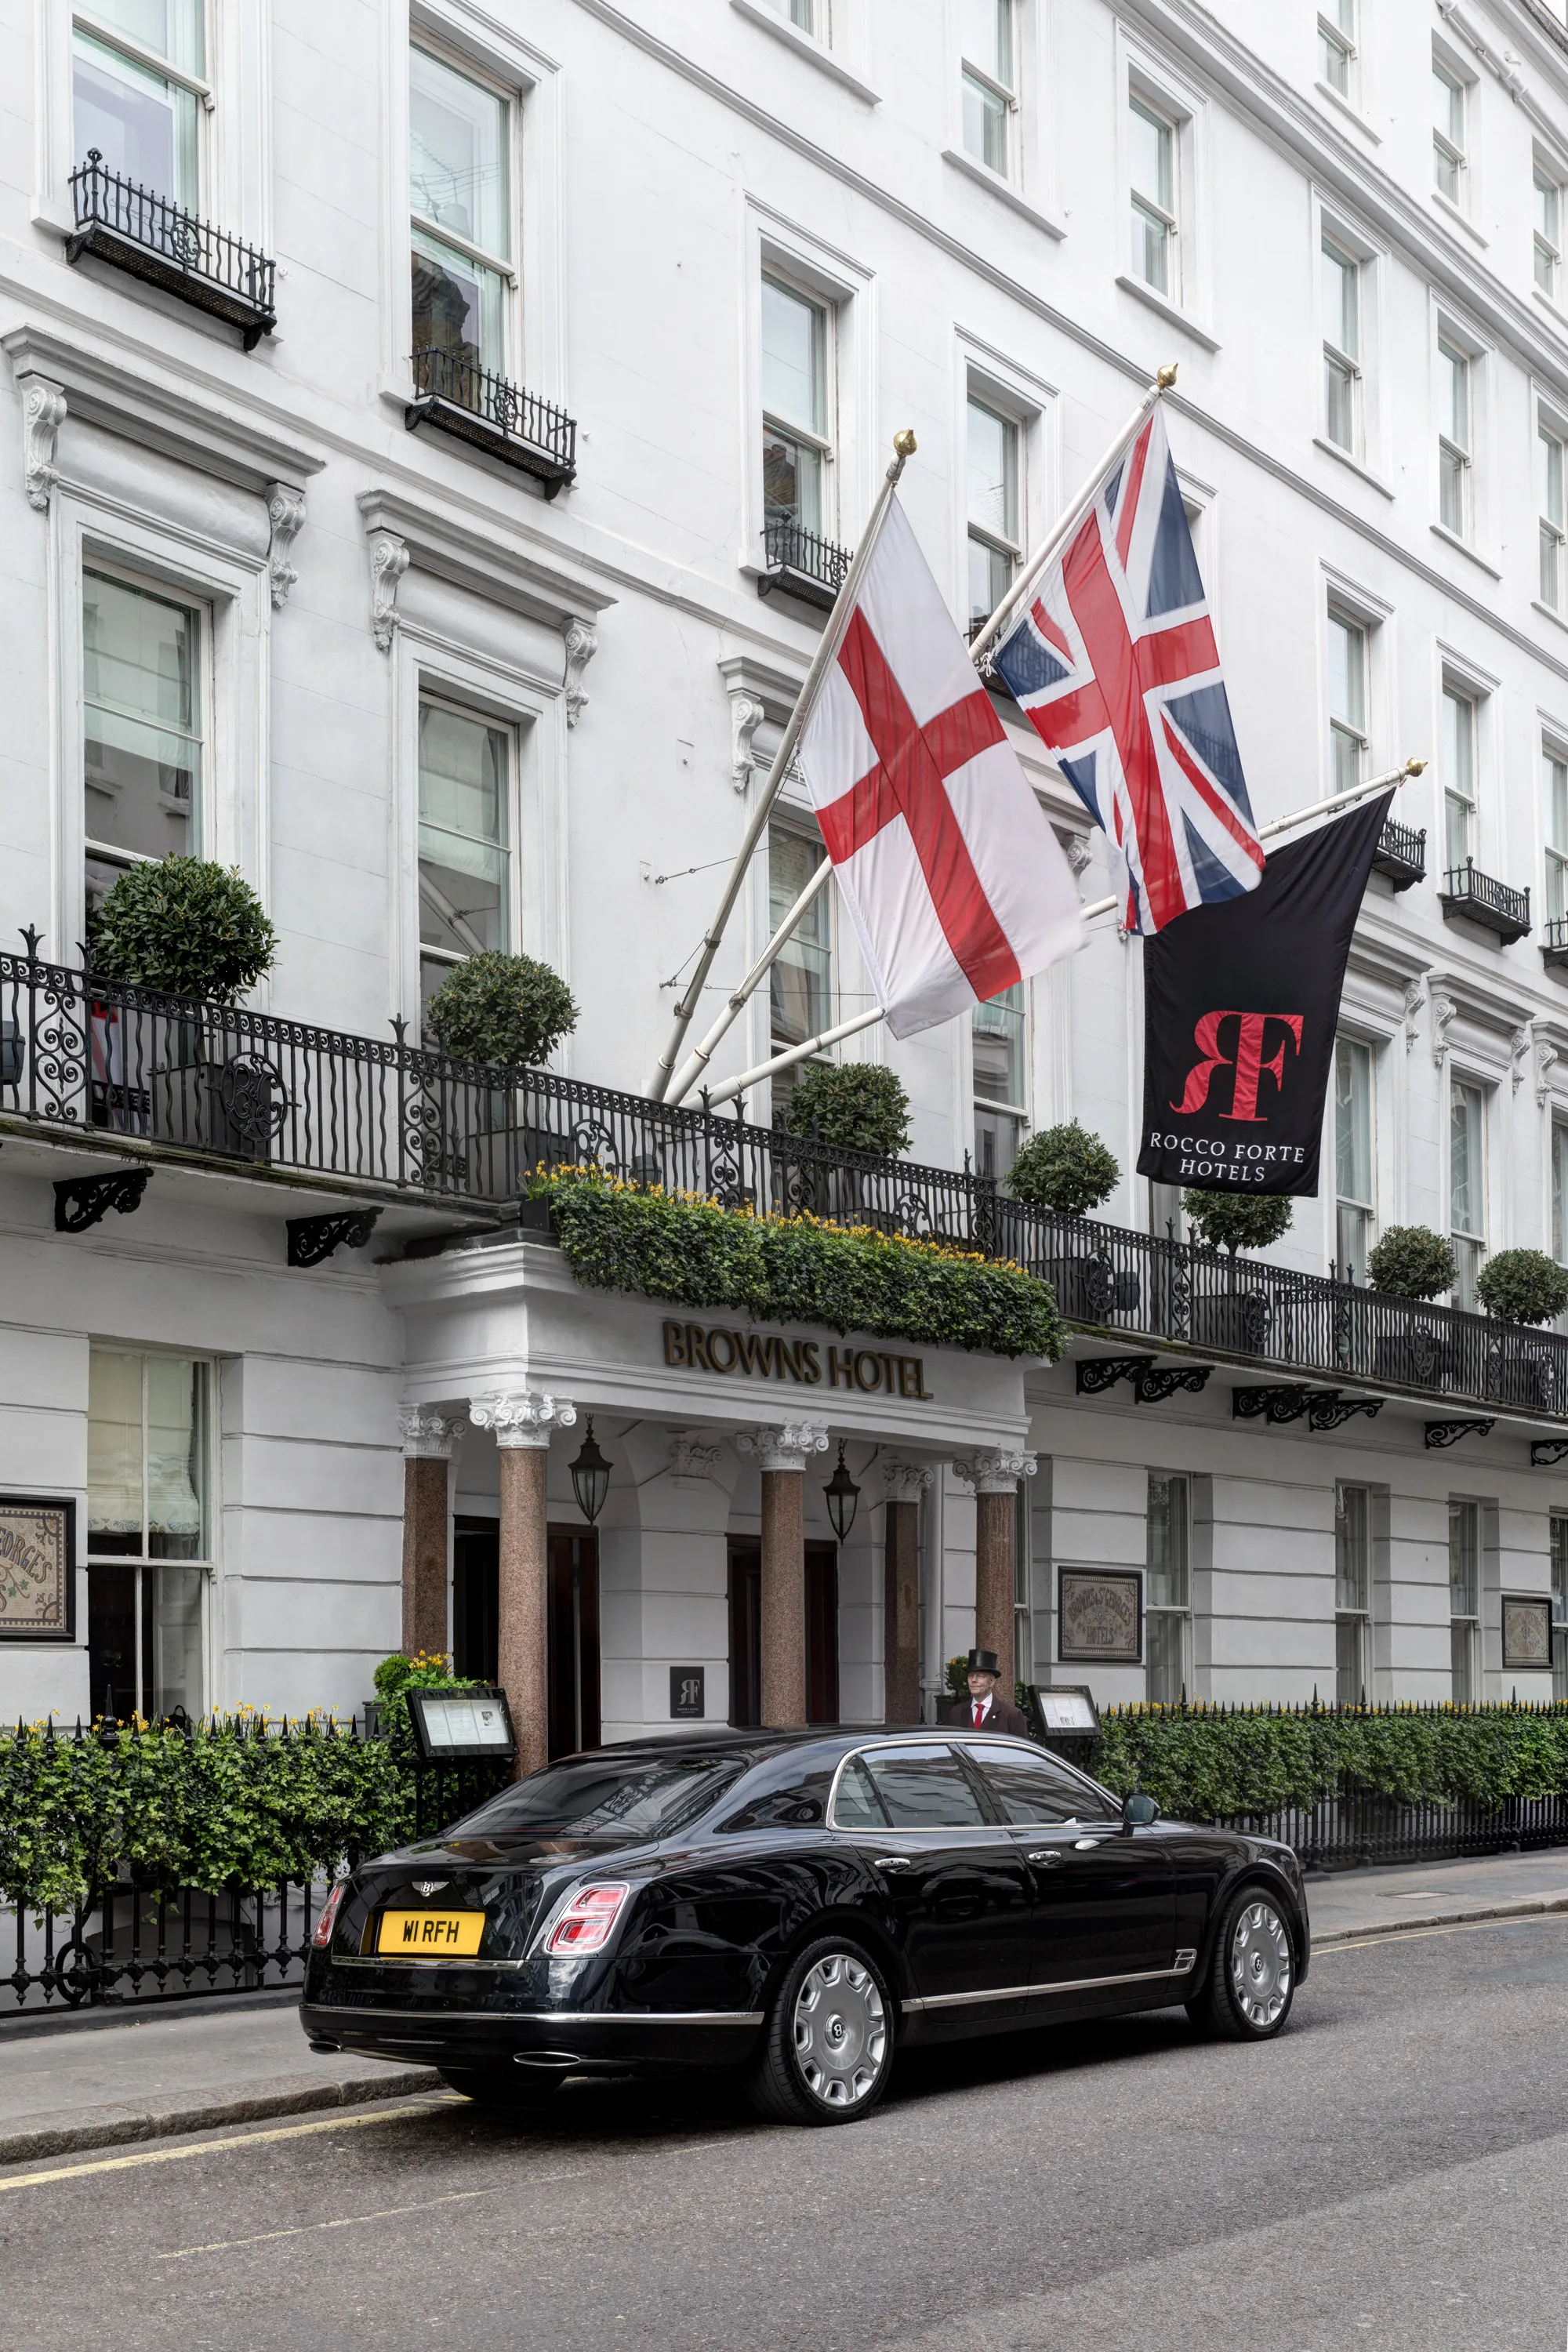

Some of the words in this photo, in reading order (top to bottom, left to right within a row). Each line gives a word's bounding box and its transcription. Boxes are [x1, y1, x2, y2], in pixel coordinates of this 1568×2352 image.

[1150, 1132, 1225, 1156] ROCCO
[1235, 1144, 1305, 1163] FORTE
[1179, 1159, 1265, 1181] HOTELS
[662, 1321, 822, 1384] BROWNS
[829, 1345, 934, 1399] HOTEL
[1086, 1625, 1114, 1645] HOTELS
[422, 1921, 459, 1943] RFH
